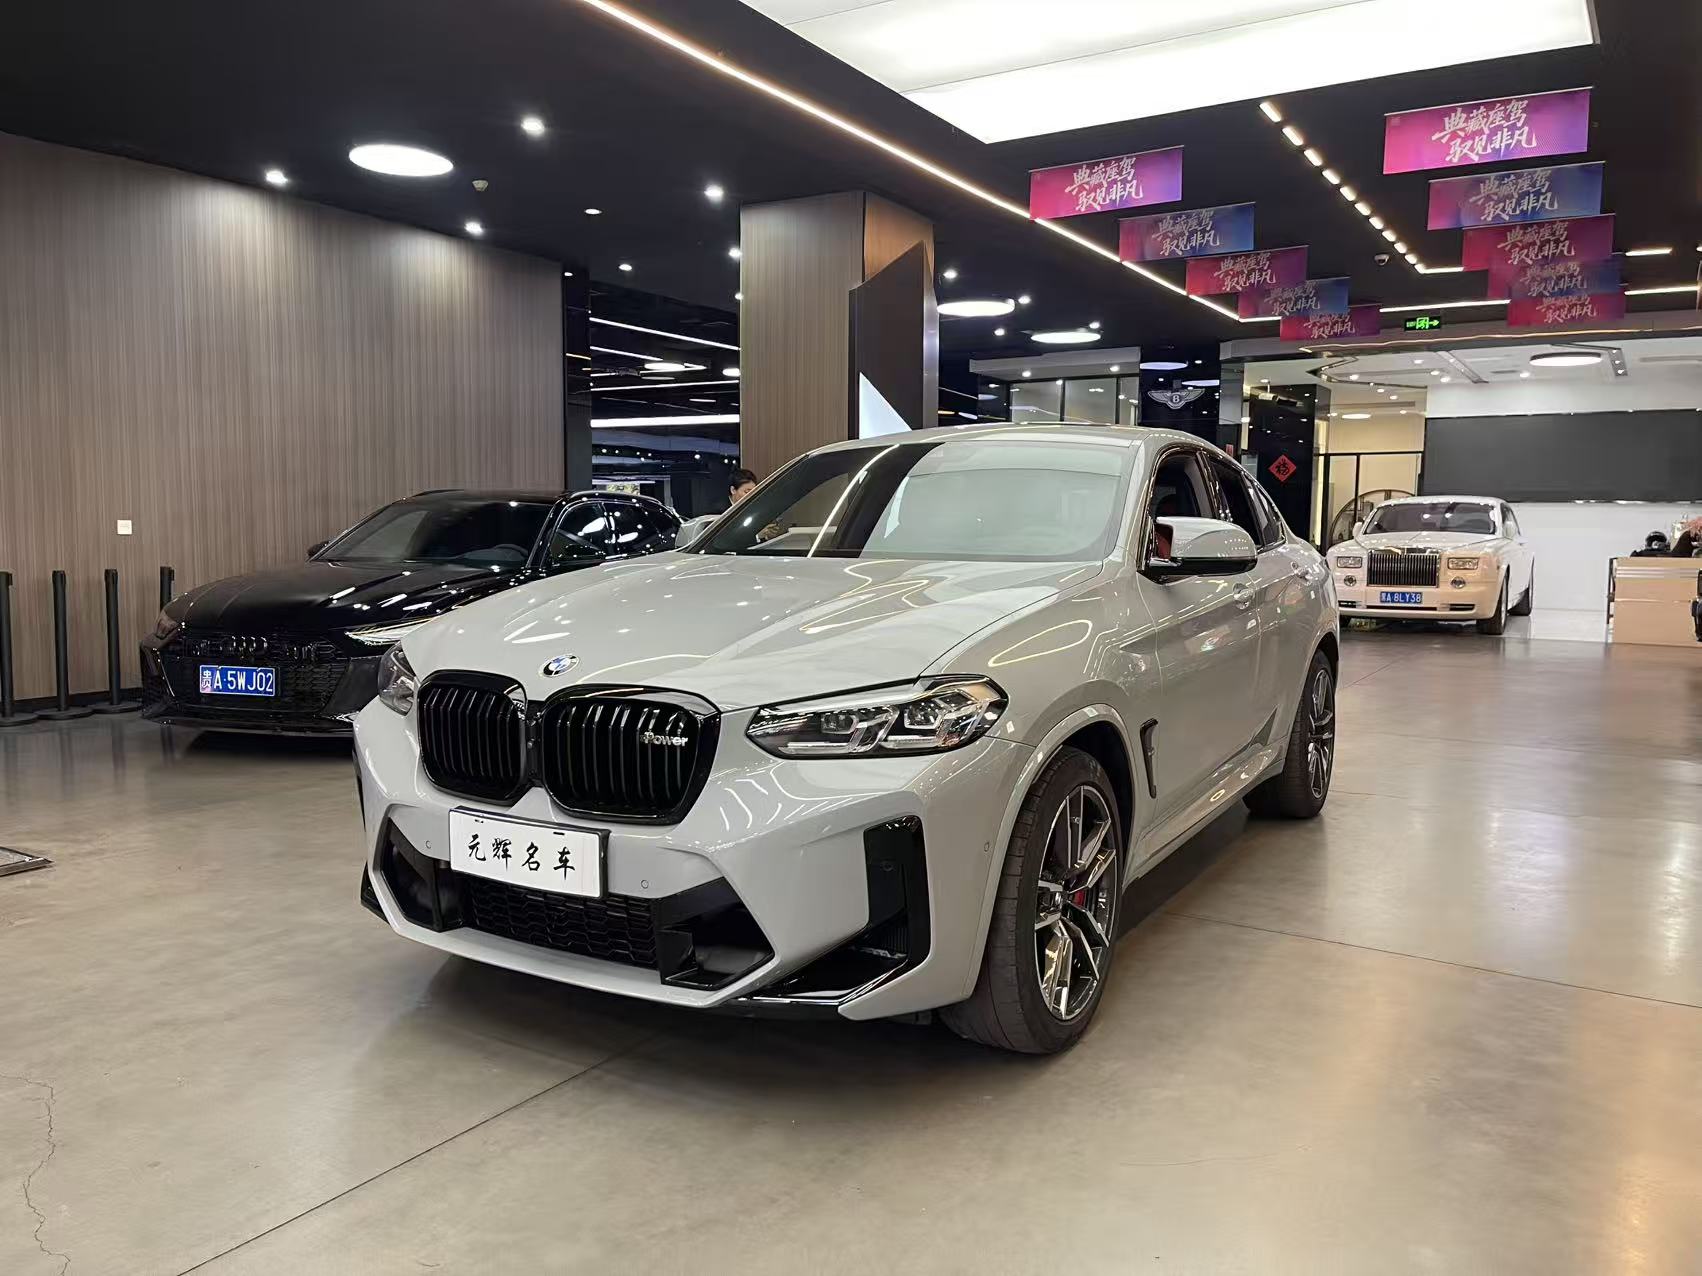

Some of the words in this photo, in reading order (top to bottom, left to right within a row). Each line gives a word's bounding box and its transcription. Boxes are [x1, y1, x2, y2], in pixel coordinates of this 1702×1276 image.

[1431, 99, 1529, 144] 典藏座驾
[1445, 127, 1537, 163] 驭见非凡
[1065, 156, 1136, 196] 典藏座驾
[1469, 169, 1552, 205] 典藏座驾
[1075, 180, 1143, 212] 驭见非凡
[1480, 192, 1559, 221] 驭见非凡
[1151, 208, 1214, 241] 典藏座驾
[1497, 221, 1569, 250] 典藏座驾
[1160, 230, 1220, 256] 驭见非凡
[1508, 240, 1575, 265] 驭见非凡
[1214, 252, 1272, 279] 典藏座驾
[1222, 269, 1276, 291] 驭见非凡
[468, 833, 576, 880] 元辉名车
